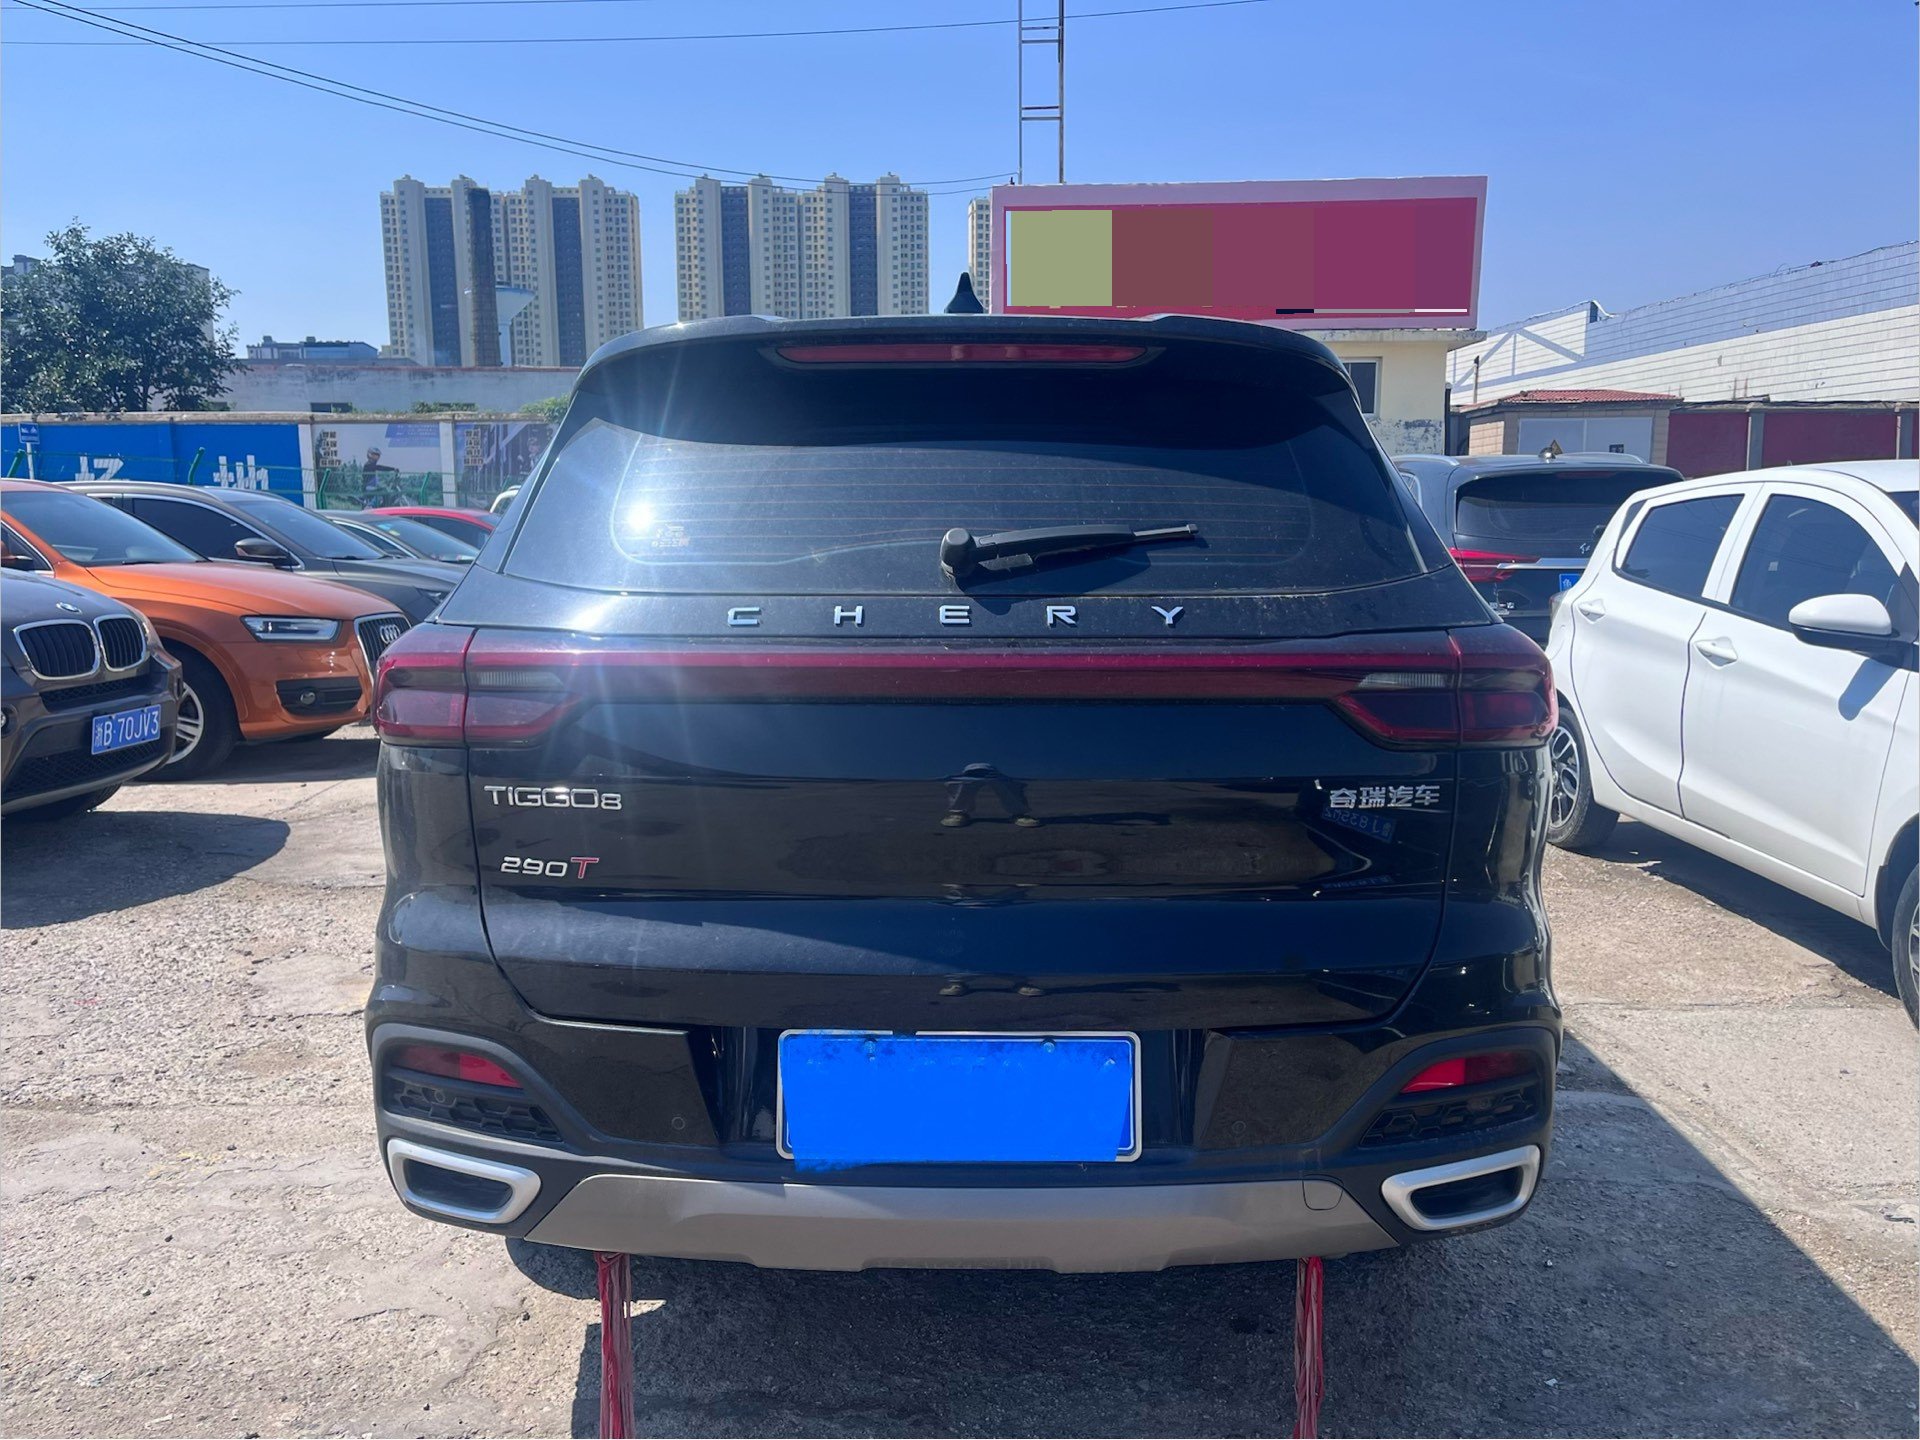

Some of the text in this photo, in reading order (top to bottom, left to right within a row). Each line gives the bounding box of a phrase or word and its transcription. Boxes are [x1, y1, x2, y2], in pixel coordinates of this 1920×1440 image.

[727, 604, 1185, 626] CHERY
[1329, 784, 1441, 809] 奇瑞汽车
[500, 856, 600, 880] 290T
